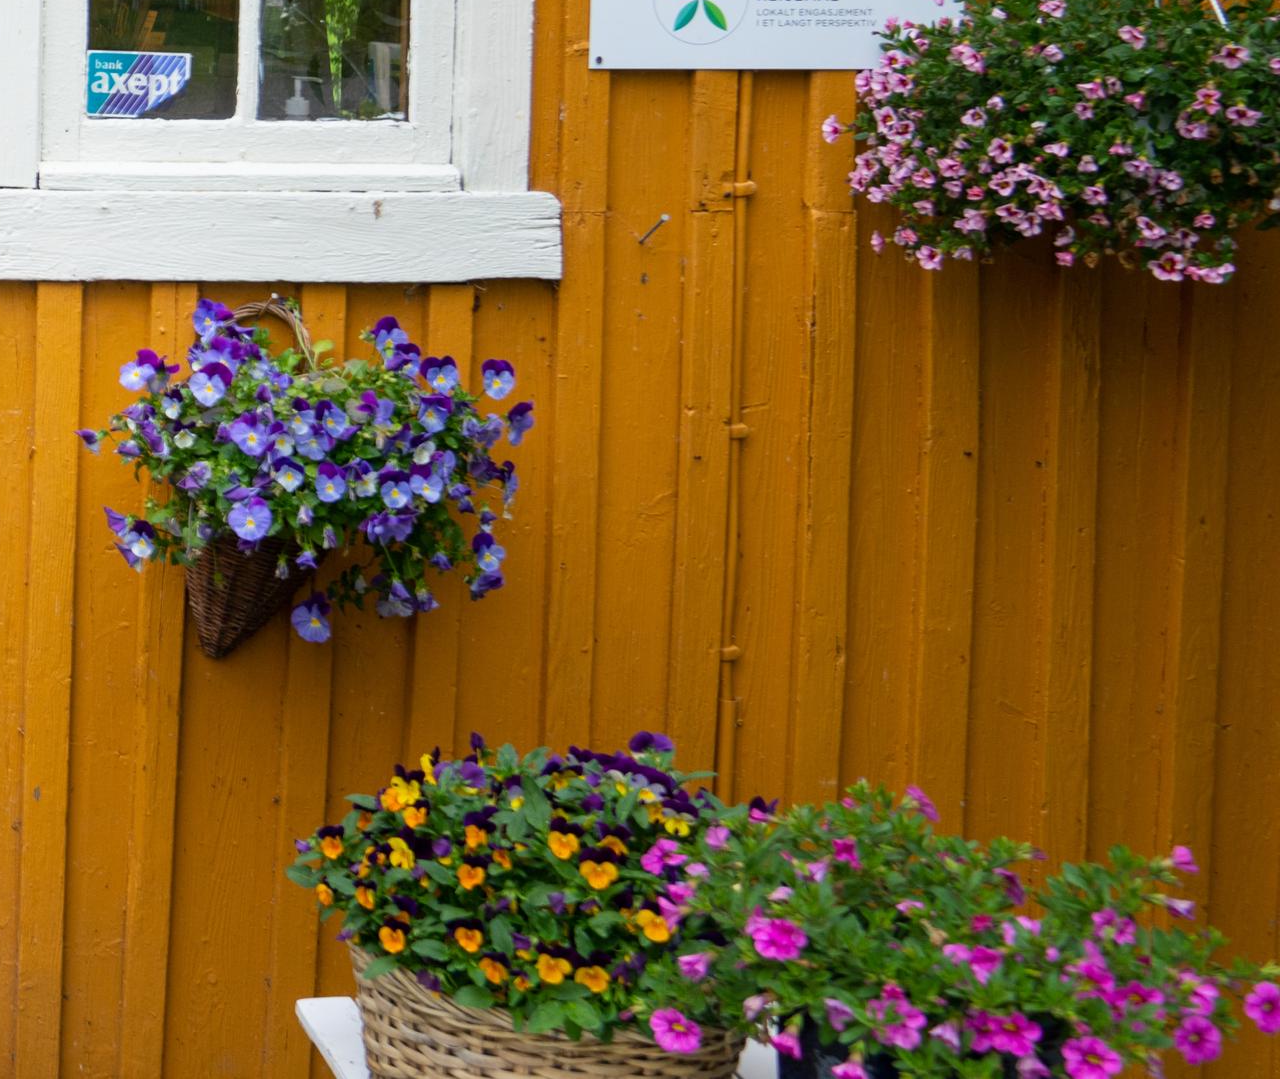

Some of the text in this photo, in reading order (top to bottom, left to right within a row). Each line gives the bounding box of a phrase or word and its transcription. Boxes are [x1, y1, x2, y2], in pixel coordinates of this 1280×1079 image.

[756, 8, 873, 17] LOKALT ENGASJEMENT
[762, 19, 775, 27] ET
[778, 19, 812, 27] LANGT
[815, 19, 877, 27] PERSPEKTIV
[95, 59, 123, 70] bank
[91, 68, 181, 110] axept
